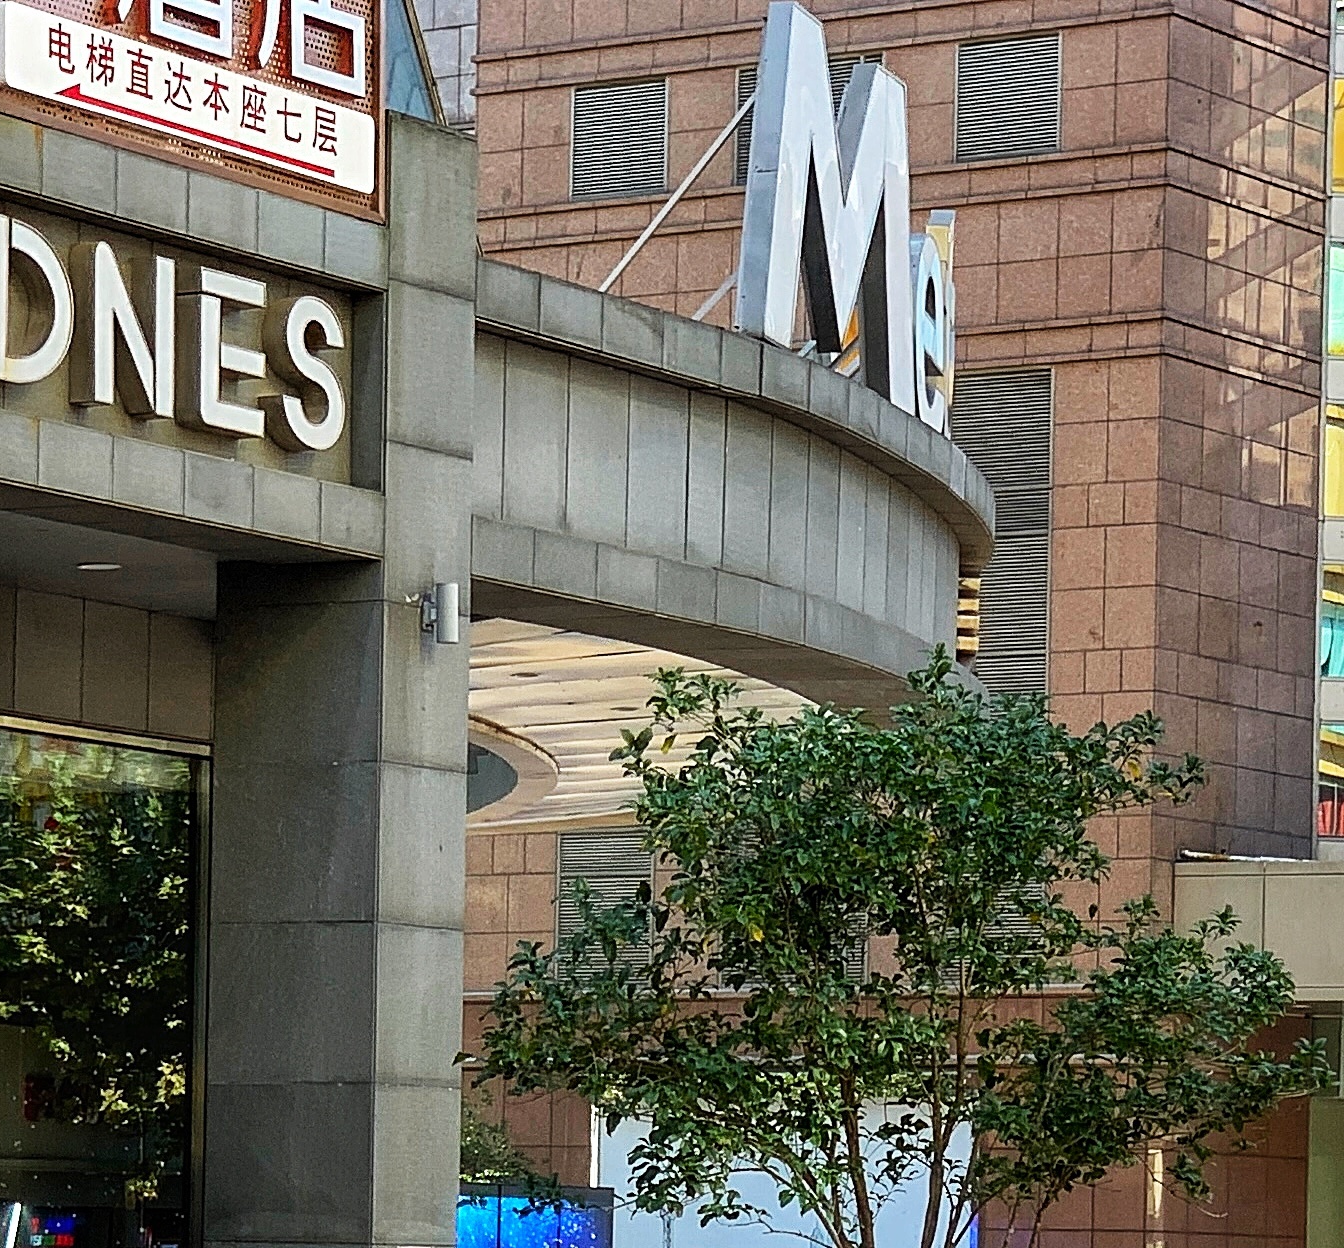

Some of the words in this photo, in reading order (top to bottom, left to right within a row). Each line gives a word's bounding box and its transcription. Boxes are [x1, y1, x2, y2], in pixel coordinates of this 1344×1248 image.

[47, 23, 338, 157] 电梯直达本座七层
